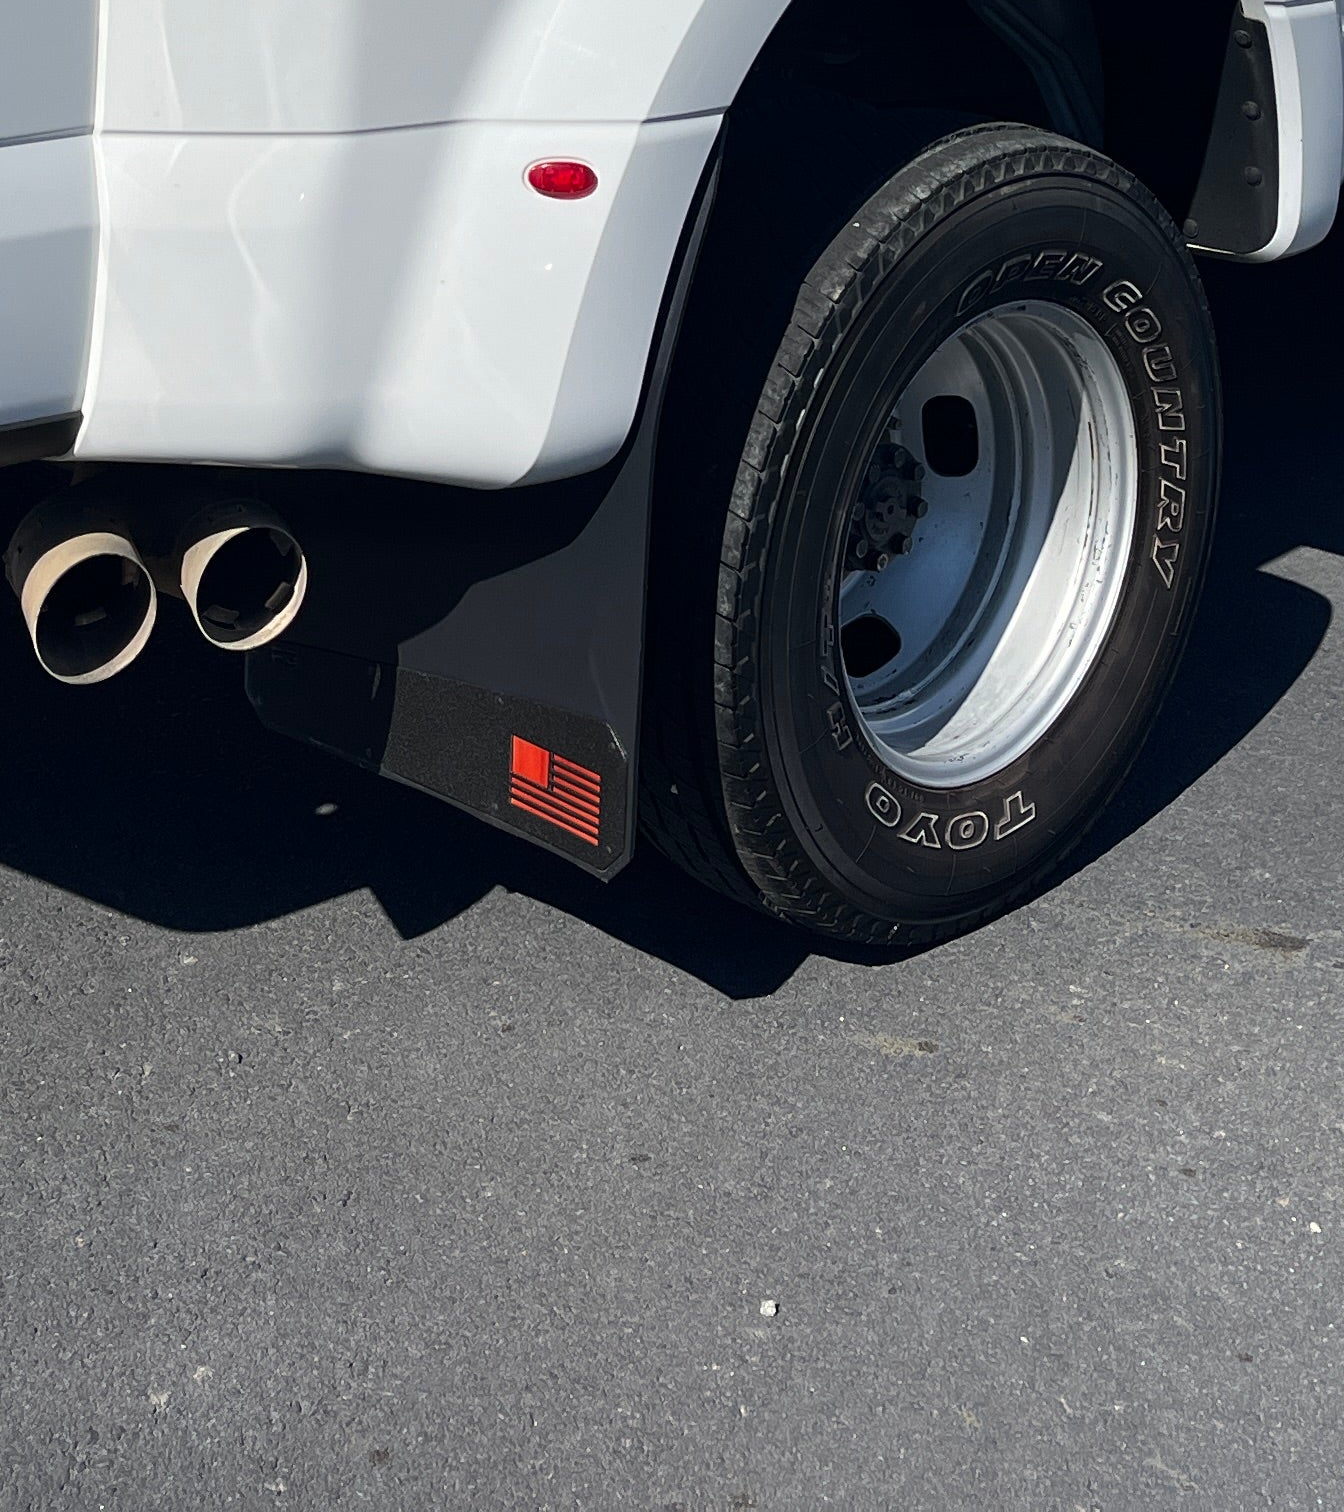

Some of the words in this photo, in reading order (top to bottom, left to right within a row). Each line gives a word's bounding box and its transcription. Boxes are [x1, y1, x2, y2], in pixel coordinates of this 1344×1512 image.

[955, 248, 1104, 318] OPEN
[1102, 280, 1187, 589] COUNTRY
[864, 782, 1036, 851] TOYO
